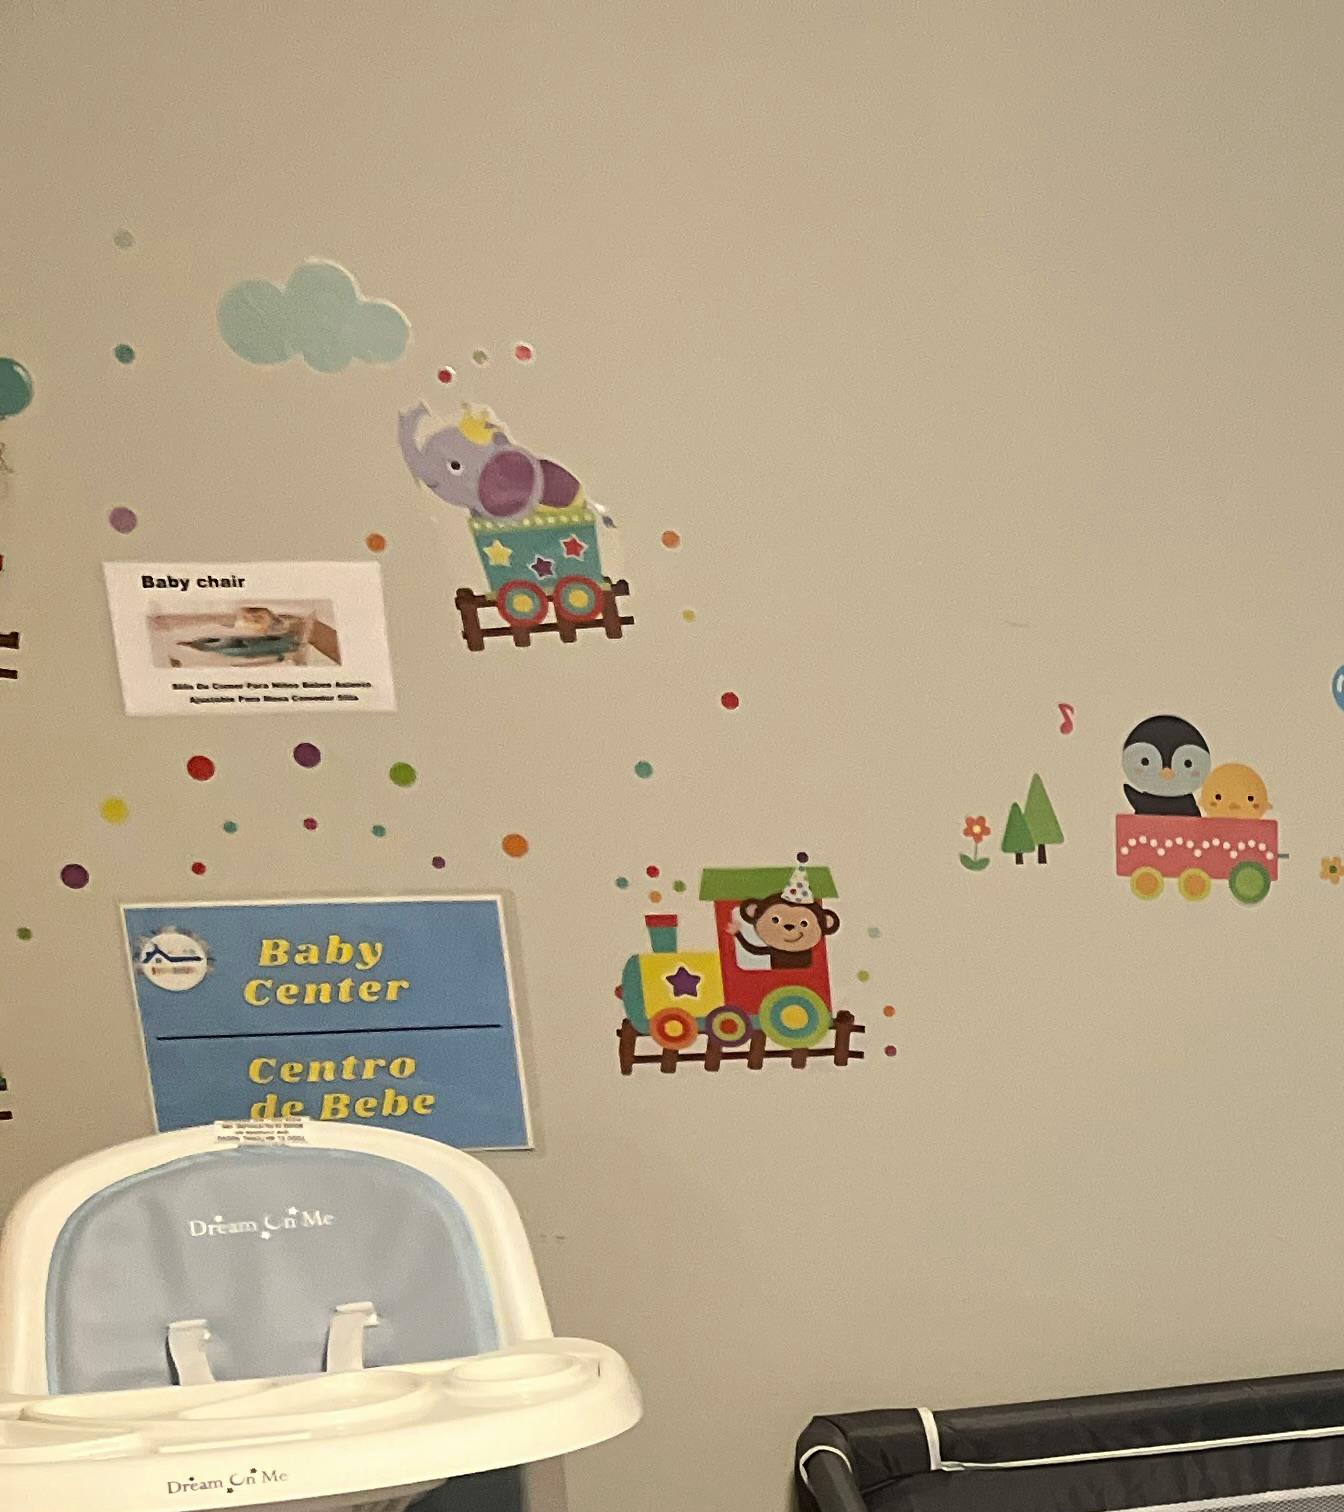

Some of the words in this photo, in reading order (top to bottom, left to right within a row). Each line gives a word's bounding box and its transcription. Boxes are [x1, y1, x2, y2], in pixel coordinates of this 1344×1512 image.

[141, 575, 190, 592] Baby
[196, 575, 246, 588] chair
[258, 933, 384, 971] Baby
[243, 976, 411, 1007] Center
[248, 1054, 418, 1085] Centro
[250, 1093, 305, 1120] de
[319, 1087, 437, 1121] Bebe
[189, 1218, 258, 1238] Dream
[264, 1213, 297, 1231] On
[301, 1209, 336, 1228] Me
[167, 1479, 224, 1494] Dream
[228, 1472, 256, 1486] On
[261, 1468, 288, 1483] Me
